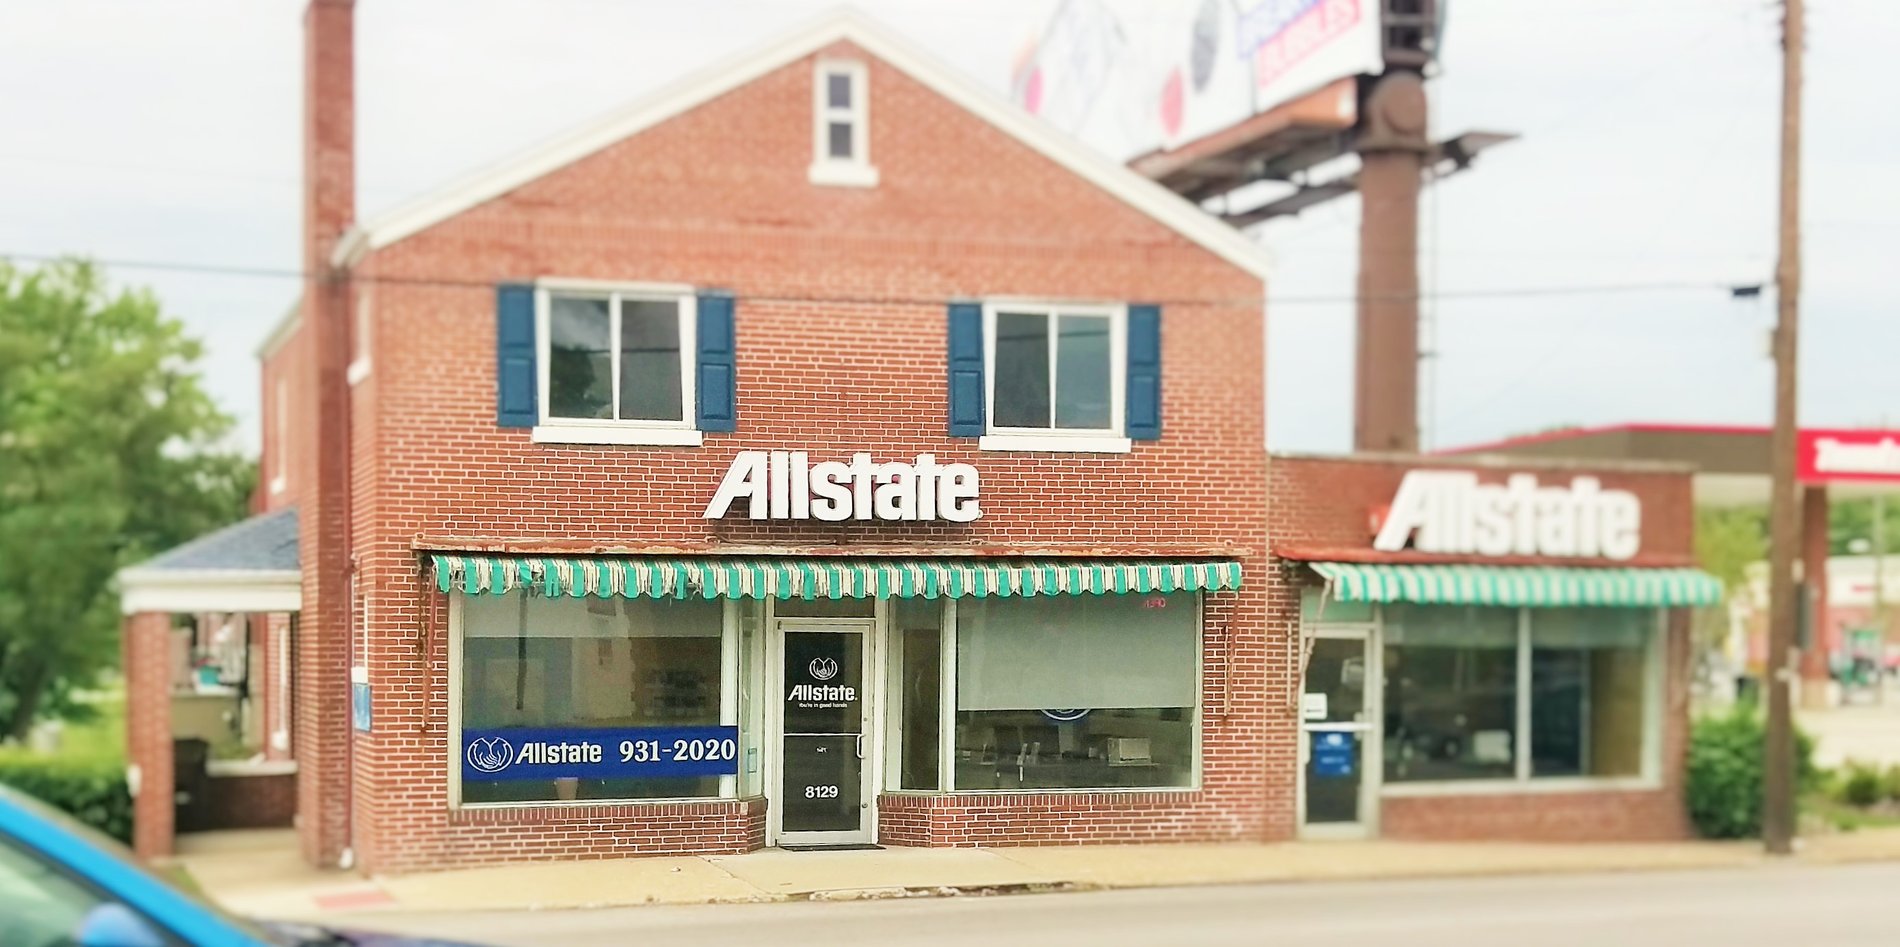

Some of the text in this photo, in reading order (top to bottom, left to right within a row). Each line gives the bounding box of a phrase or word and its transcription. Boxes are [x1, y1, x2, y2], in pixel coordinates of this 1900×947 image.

[702, 449, 982, 522] Allstate
[1373, 468, 1641, 560] Allstate
[515, 738, 736, 764] Allstate 931-2020
[805, 785, 839, 799] 8129
